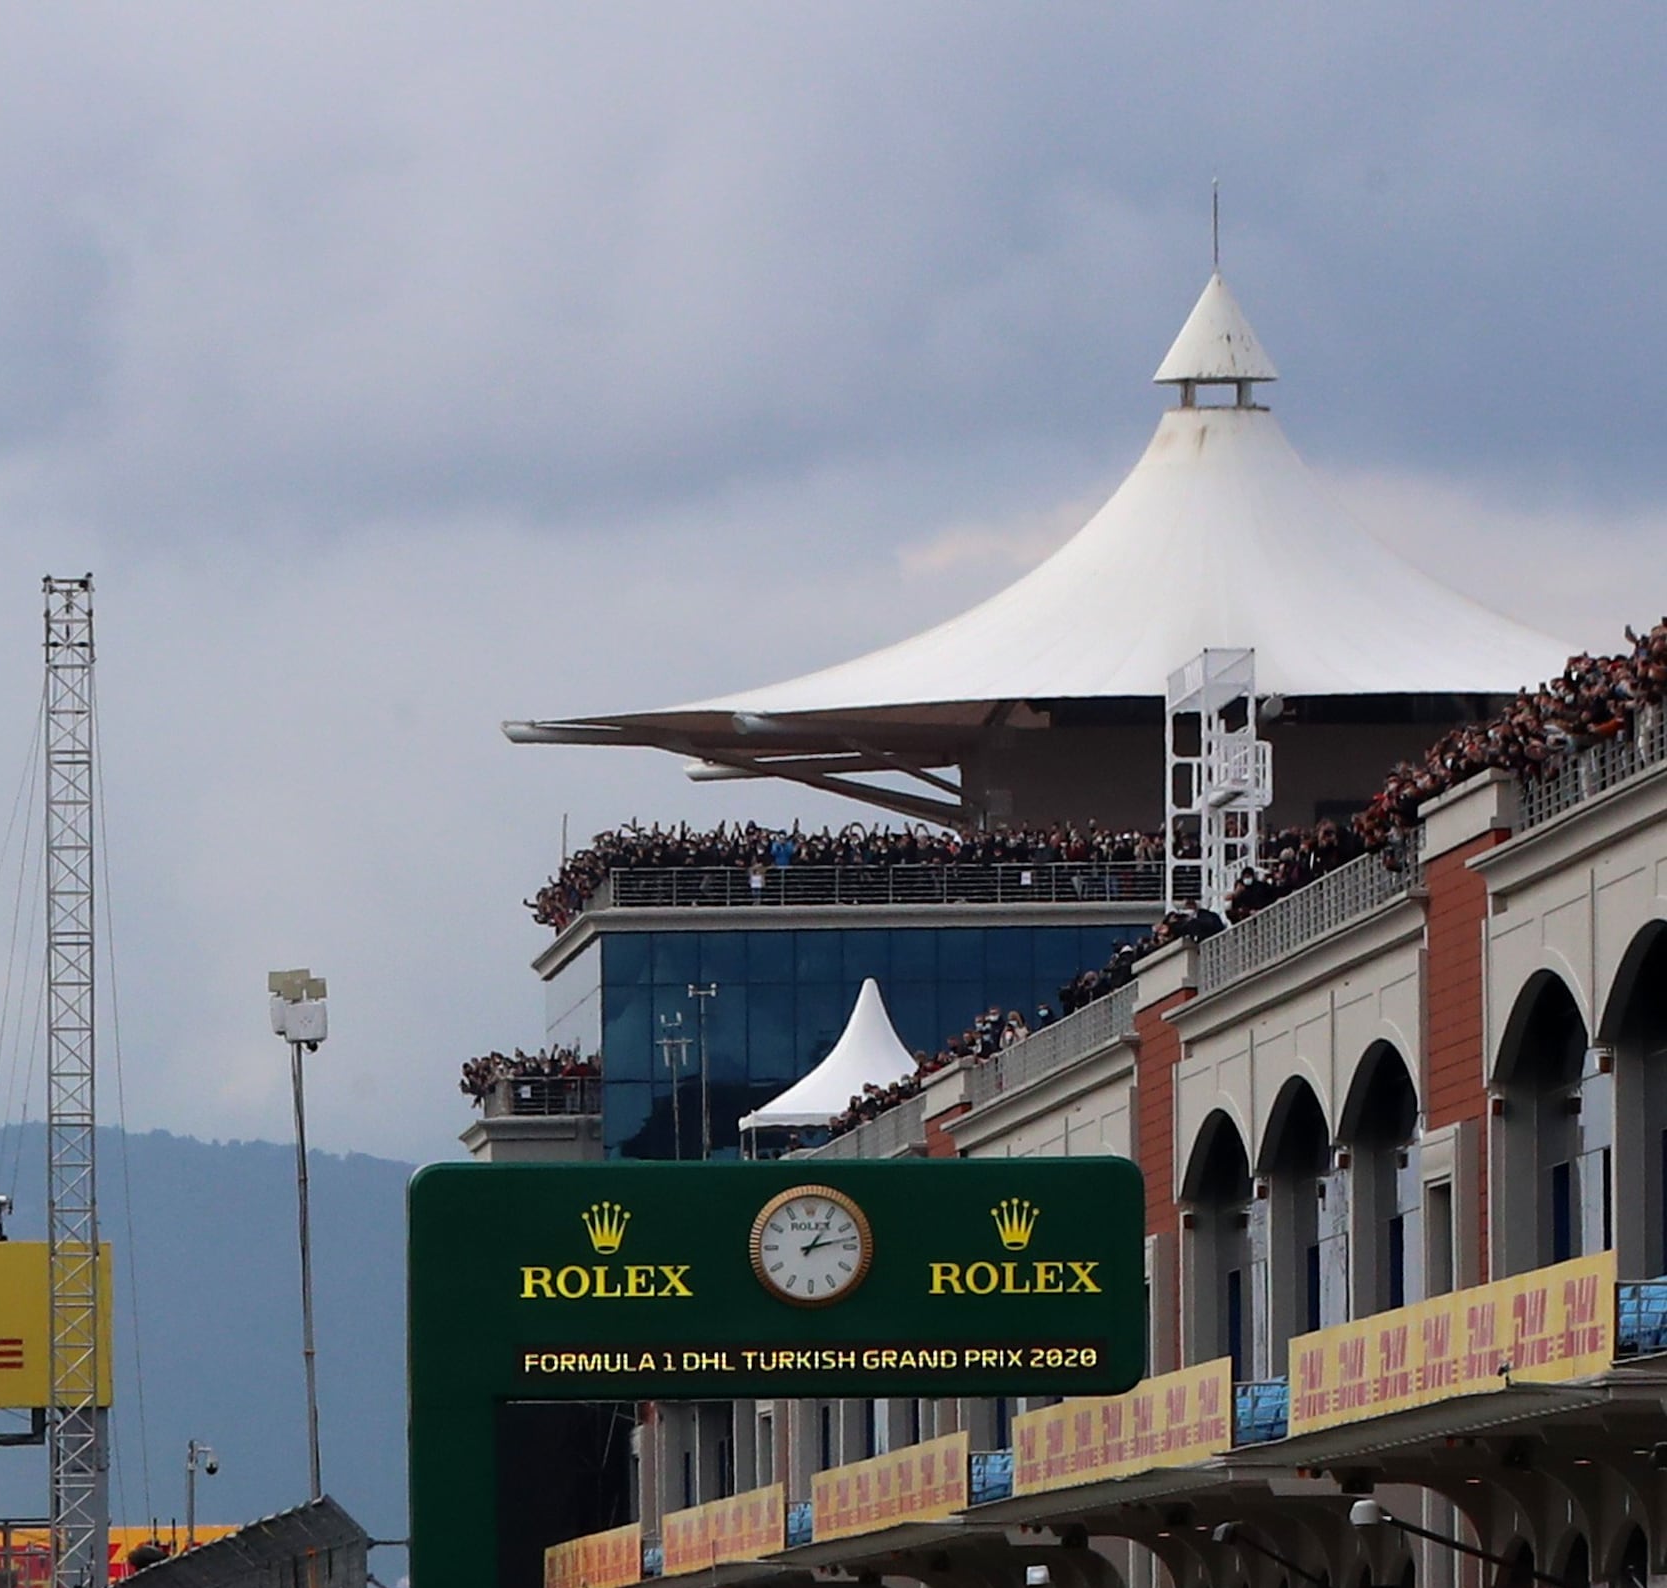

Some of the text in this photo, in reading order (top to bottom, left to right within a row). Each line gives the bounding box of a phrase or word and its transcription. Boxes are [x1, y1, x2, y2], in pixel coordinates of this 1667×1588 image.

[519, 1265, 694, 1299] ROLEX
[928, 1261, 1102, 1295] ROLEX
[525, 1347, 1097, 1373] FORMULA 1 DHL TURKISH GRAND PRIX 2020
